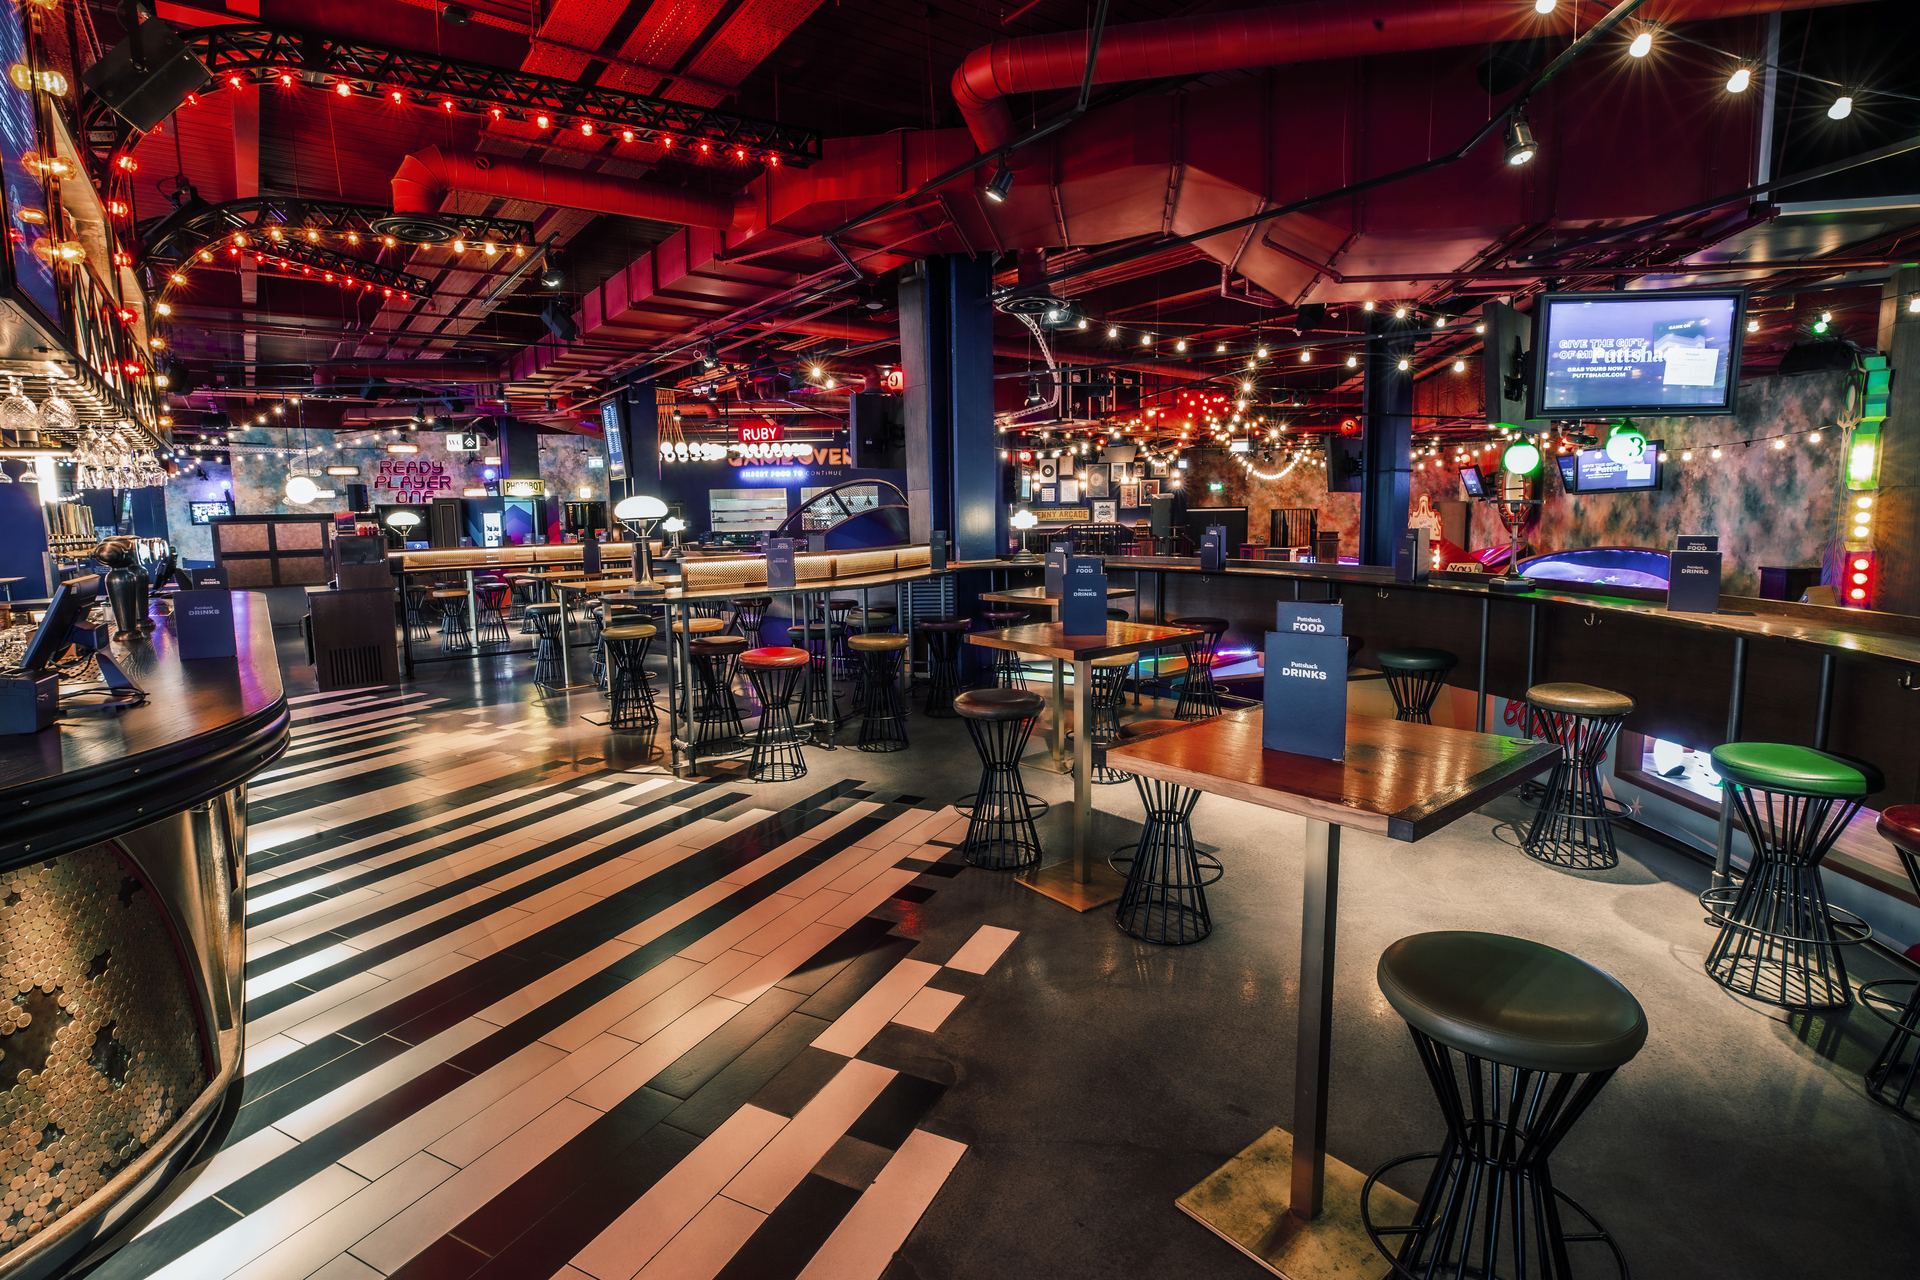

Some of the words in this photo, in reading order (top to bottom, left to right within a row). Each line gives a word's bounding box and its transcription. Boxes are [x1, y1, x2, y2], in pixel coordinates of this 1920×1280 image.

[1558, 340, 1588, 349] GIVE
[1590, 339, 1614, 348] THE
[1616, 338, 1644, 347] GIFT
[1558, 350, 1576, 360] OF
[1590, 346, 1667, 364] Puttsha
[890, 374, 899, 387] 9
[743, 428, 776, 440] RUBY
[1628, 436, 1644, 457] 3
[379, 460, 444, 476] READY
[742, 470, 769, 478] INSERT
[770, 470, 791, 478] FOOD
[793, 469, 804, 477] TO
[374, 475, 452, 491] PLAYER
[1059, 510, 1088, 518] ARCADE
[1293, 622, 1325, 633] FOOD
[1291, 662, 1318, 670] Puttshack
[1282, 668, 1327, 680] DRINKS
